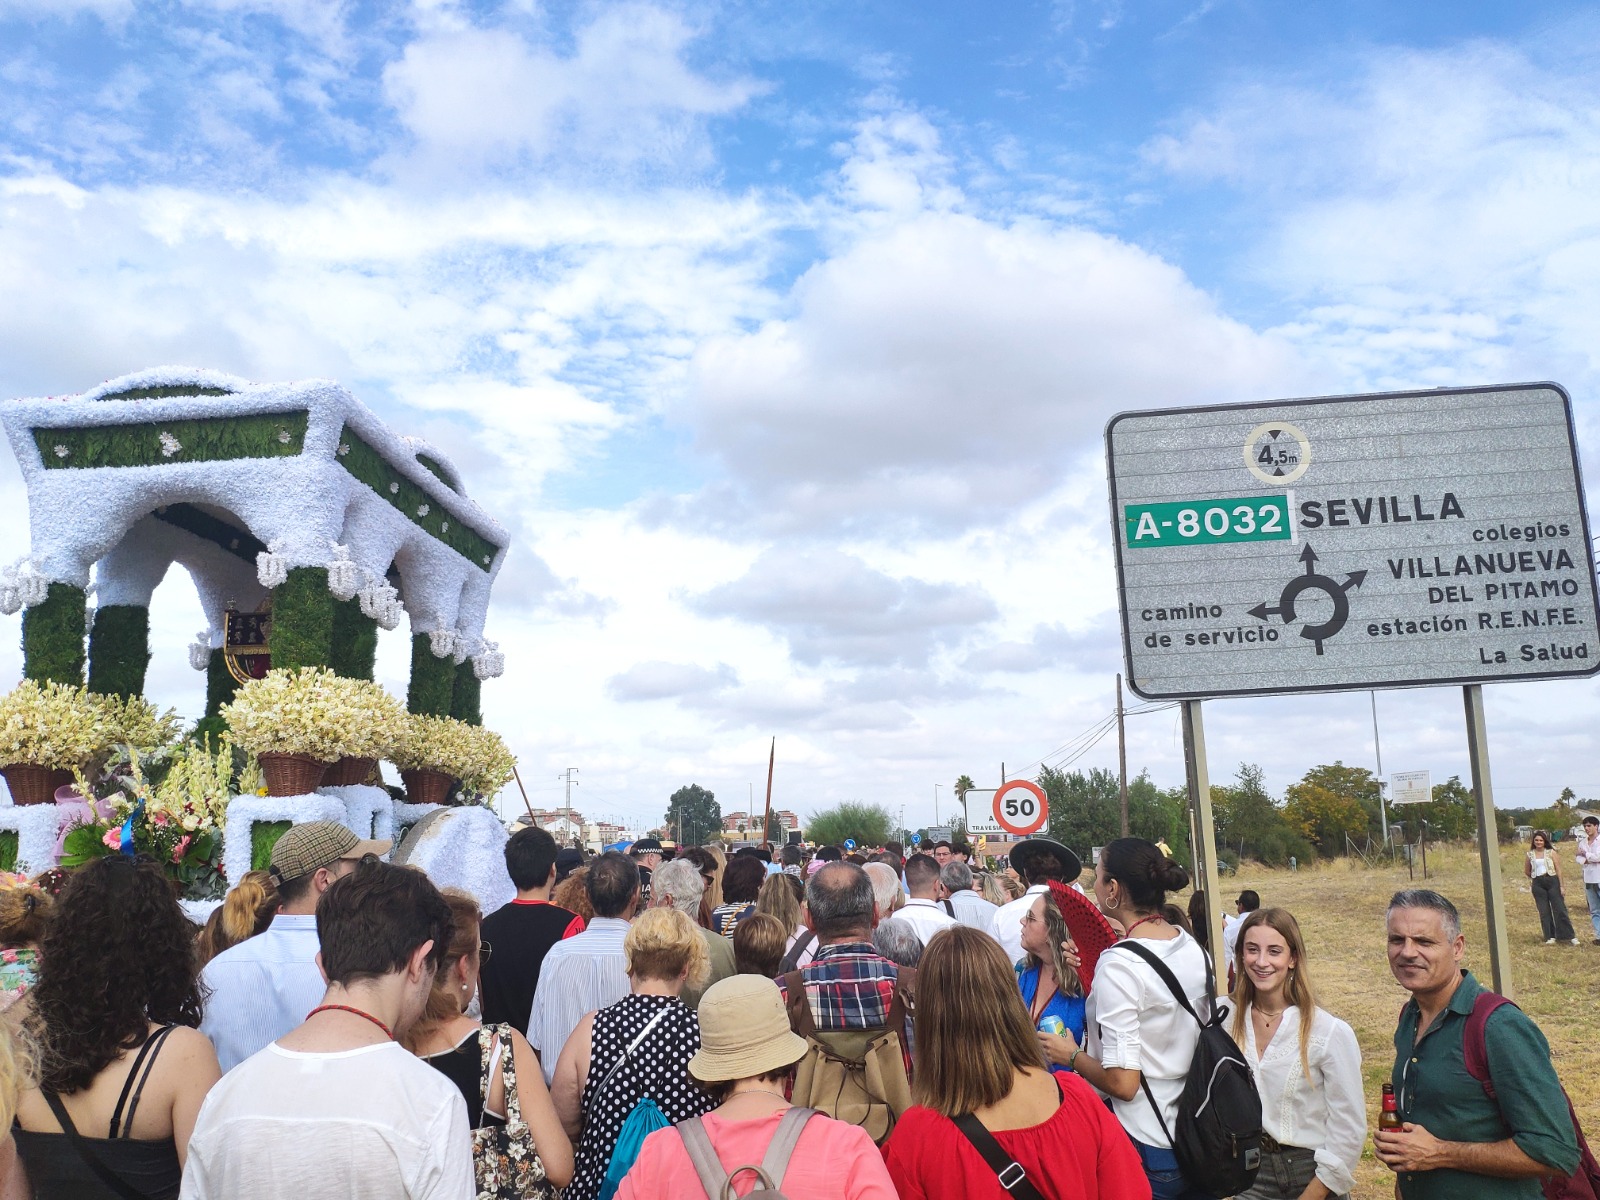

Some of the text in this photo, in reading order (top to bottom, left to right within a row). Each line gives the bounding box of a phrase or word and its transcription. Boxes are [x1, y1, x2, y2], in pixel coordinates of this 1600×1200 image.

[1258, 445, 1297, 466] 4,5m
[1300, 492, 1465, 528] SEVILLA
[1135, 505, 1282, 540] A-8032
[1472, 522, 1570, 542] colegios
[1387, 549, 1575, 579] VILLANUEVA
[1429, 579, 1579, 604] DEL PITAMO
[1141, 602, 1222, 621] camino
[1367, 607, 1583, 636] estación R.E.N.F.E.
[1144, 625, 1279, 648] de servicio
[1479, 643, 1588, 664] La Salud
[1005, 799, 1034, 816] 50
